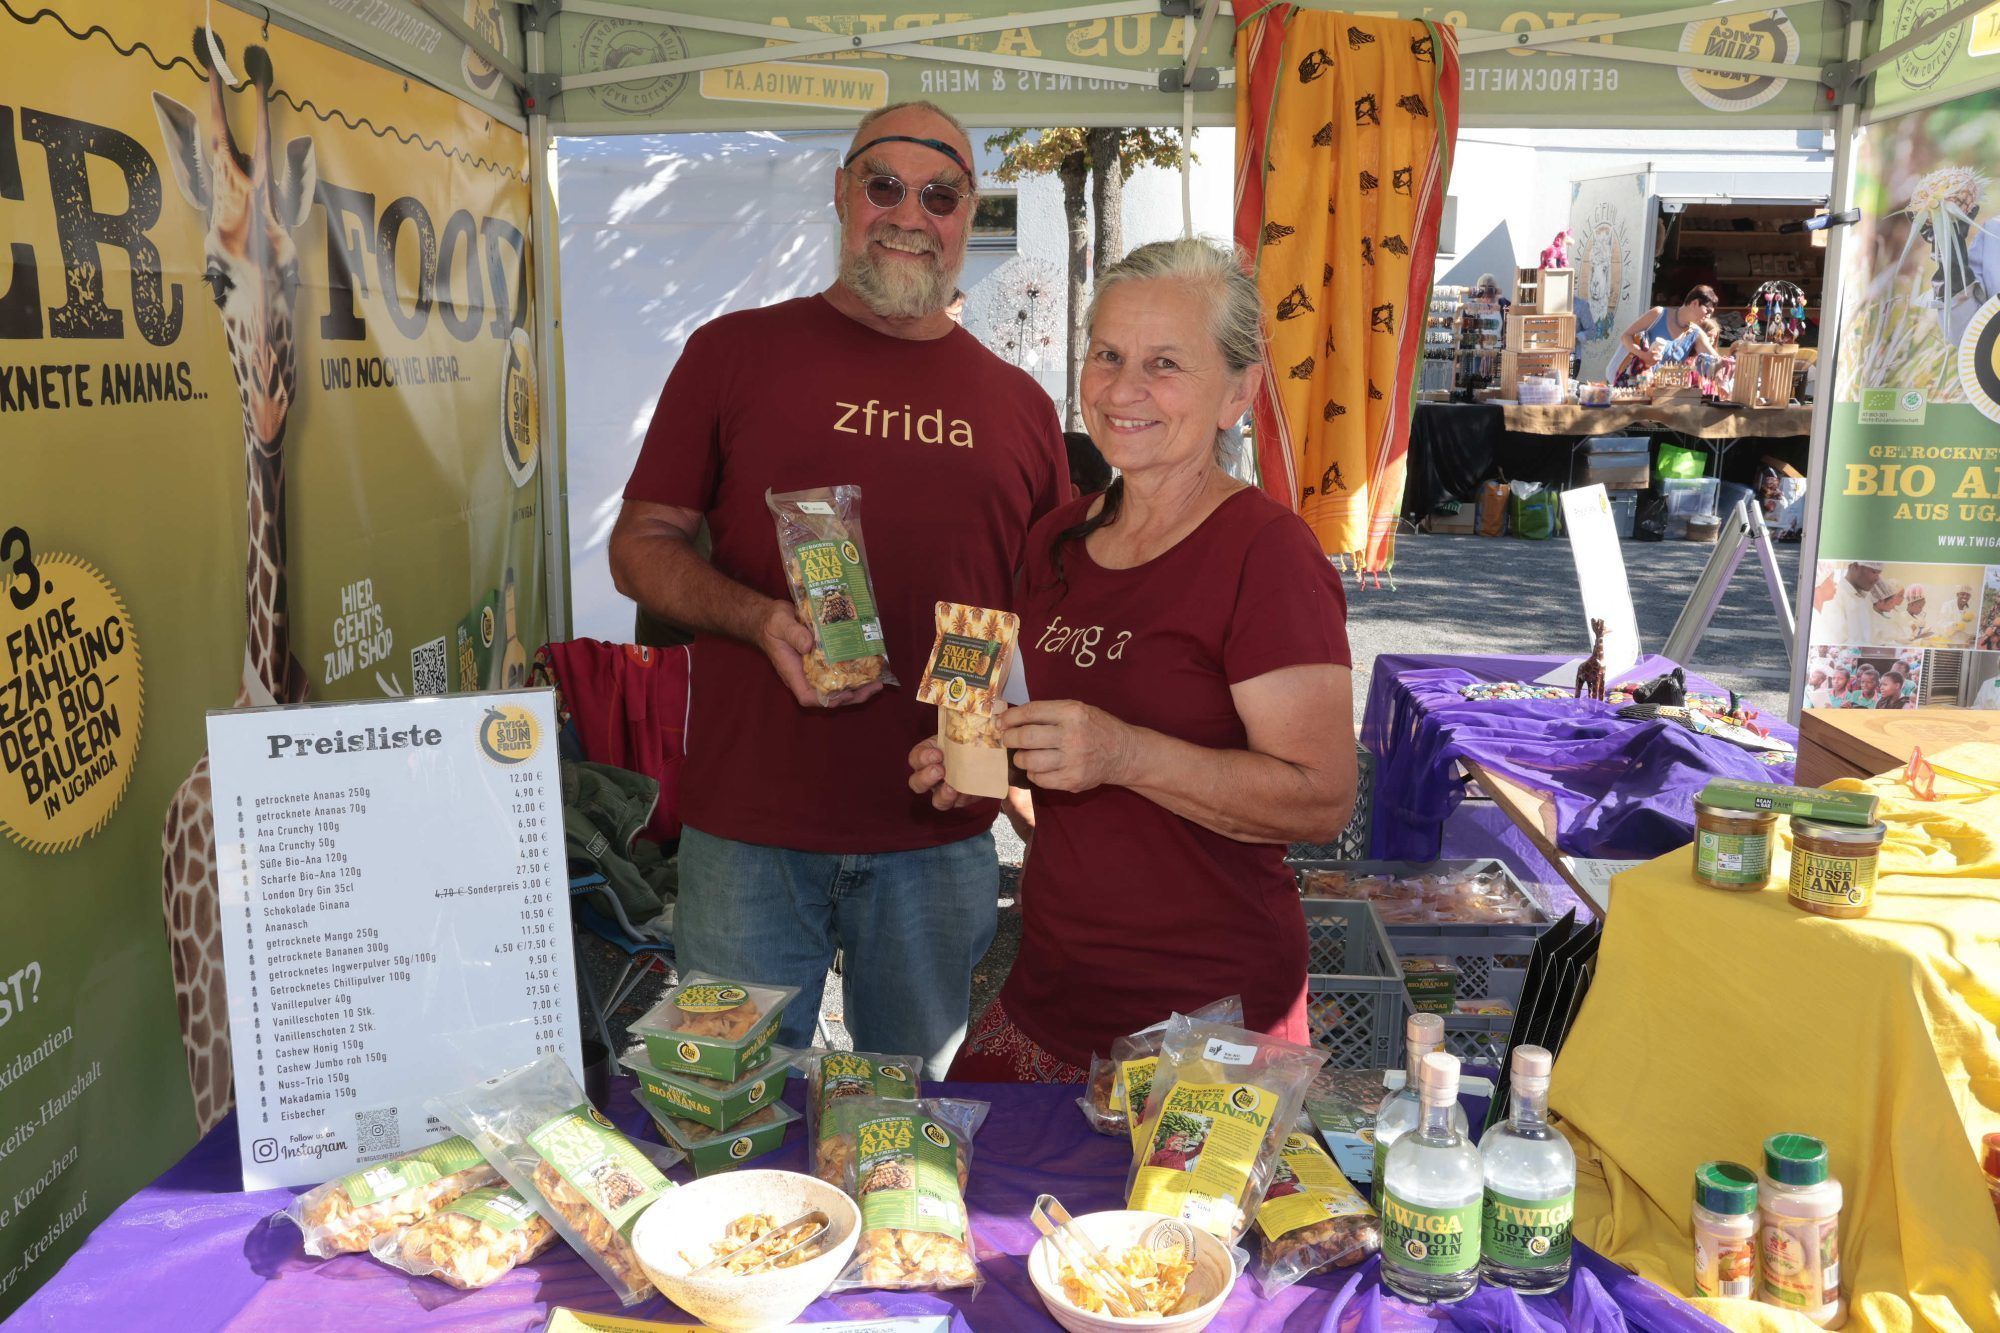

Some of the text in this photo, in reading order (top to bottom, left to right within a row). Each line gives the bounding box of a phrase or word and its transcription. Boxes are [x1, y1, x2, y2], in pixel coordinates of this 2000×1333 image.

[321, 357, 351, 390] UND
[357, 356, 402, 388] NOCH
[403, 356, 425, 385] VIEL
[101, 361, 208, 405] ANANAS...
[833, 400, 974, 449] zfrida
[1869, 445, 2000, 460] GETROCKNE
[1843, 463, 1936, 497] BIO
[1893, 503, 2000, 522] AUS UG
[0, 526, 54, 610] 3.
[804, 556, 843, 572] ANA
[806, 566, 843, 583] NAS
[341, 578, 373, 615] HIER
[333, 604, 383, 648] GEHT'S
[6, 597, 82, 675] FAIRE
[324, 628, 393, 685] ZUM SHOP
[943, 644, 983, 661] SNACK
[1, 674, 120, 773] DER BIO-
[497, 719, 529, 729] TWIGA
[266, 723, 443, 760] Preisliste
[497, 728, 531, 743] SUN
[21, 703, 122, 805] BAUERN
[497, 741, 532, 751] FRUITS
[44, 750, 118, 820] IN UGANDA
[509, 772, 533, 783] 12.00
[255, 786, 370, 808] getrocknete Ananas 250g
[514, 787, 534, 798] 4.90
[256, 803, 366, 824] getrocknete Ananas 70g
[257, 828, 274, 837] Ana
[277, 823, 314, 836] Crunchy
[258, 837, 335, 853] Ana Crunchy 50g
[259, 852, 347, 869] Süße Bio-Ana 120g
[516, 863, 541, 875] 27.50
[1807, 855, 1853, 871] TWIGA
[299, 869, 336, 881] Bio-Ana
[339, 866, 361, 878] 120g
[262, 889, 295, 901] London
[316, 885, 331, 895] Gin
[467, 881, 519, 896] Sonderpreis
[522, 879, 541, 890] 3.00
[1810, 878, 1851, 894] ANA
[263, 901, 350, 917] Schokolade Ginana
[264, 919, 308, 932] Ananasch
[266, 927, 378, 951] getrocknete Mango 250g
[494, 942, 513, 953] 4.50
[267, 942, 389, 966] getrocknete Bananen 300g
[331, 958, 390, 974] Ingwerpulver
[525, 984, 550, 996] 27.50
[270, 993, 351, 1011] Vanillepulver 40g
[343, 1008, 354, 1018] 10
[273, 1026, 346, 1042] Vanillenschoten
[349, 1023, 355, 1034] 2
[275, 1039, 364, 1058] Cashew Honig 150g
[276, 1051, 387, 1074] Cashew Jumbo roh 150g
[278, 1072, 349, 1090] Nuss-Trio 150g
[279, 1086, 356, 1105] Makadamia 150g
[647, 1083, 712, 1115] BIOANANAS
[280, 1107, 325, 1121] Eisbecher
[1168, 1097, 1267, 1128] BANANEN
[289, 1133, 313, 1143] Follow
[861, 1127, 914, 1145] ANA
[281, 1141, 349, 1160] Instagram
[861, 1137, 911, 1159] NAS
[13, 1145, 79, 1219] Knochen
[1385, 1194, 1464, 1234] TWIGA
[1495, 1201, 1573, 1227] TWIGA
[1385, 1218, 1462, 1245] LONDON
[1427, 1243, 1462, 1256] GIN
